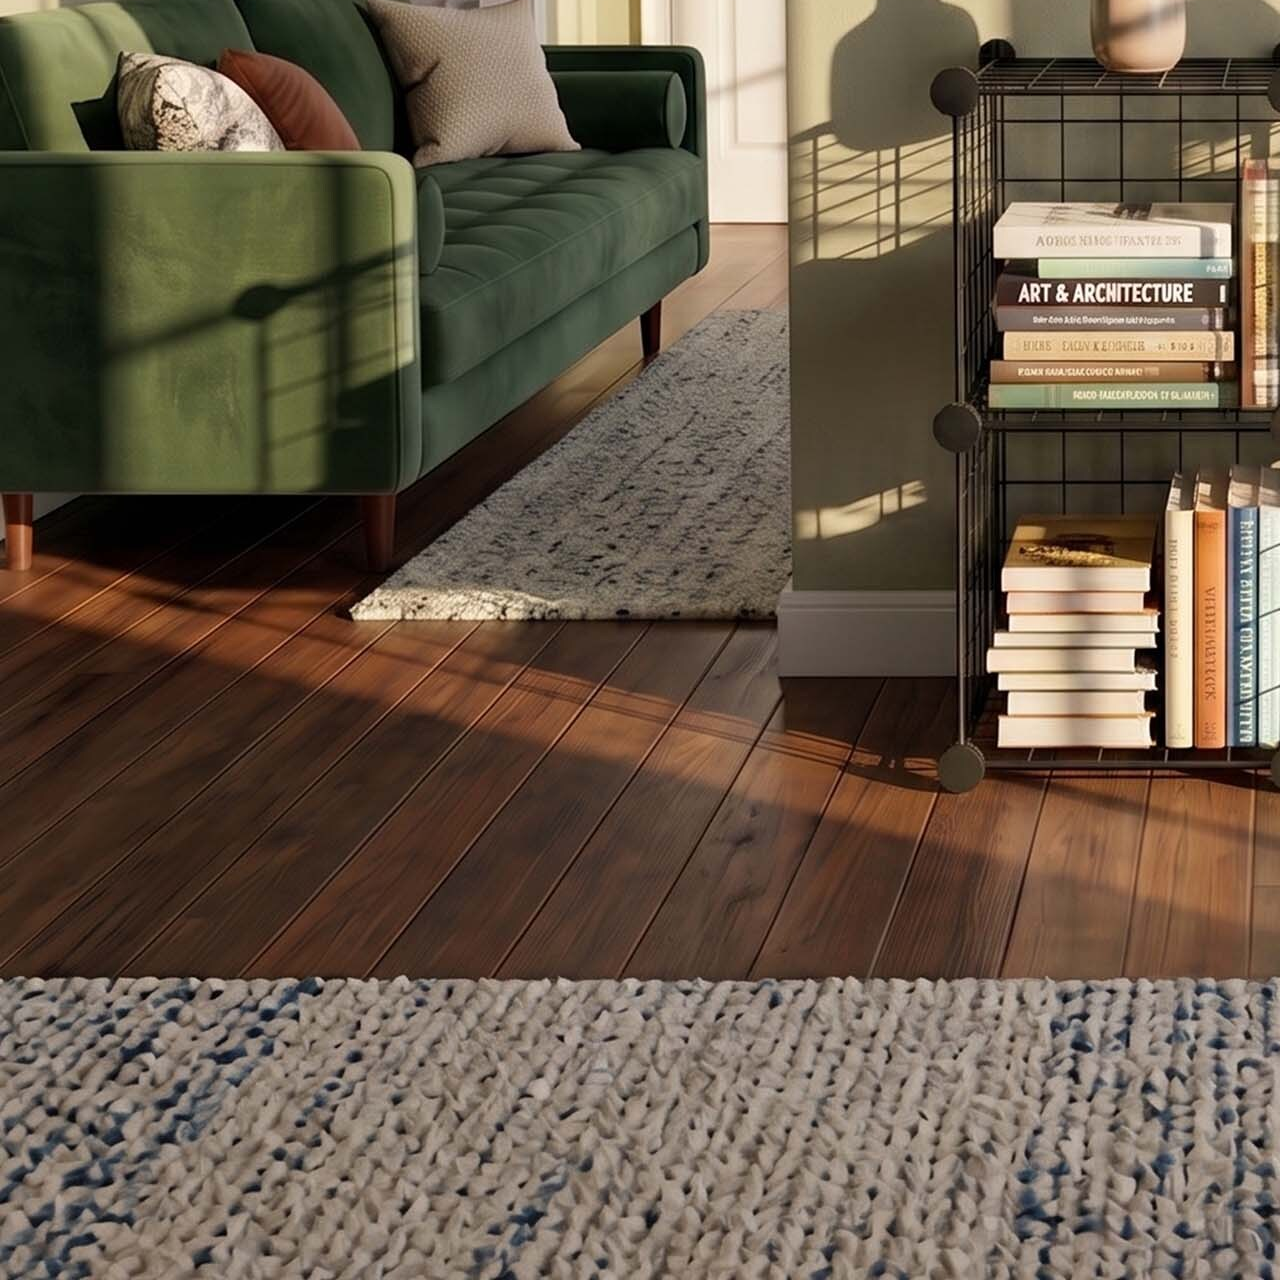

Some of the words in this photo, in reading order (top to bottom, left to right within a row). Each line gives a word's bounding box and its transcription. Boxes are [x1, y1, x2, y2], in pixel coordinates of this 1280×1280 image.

[1018, 283, 1052, 303] ART
[1055, 283, 1069, 303] &
[1072, 283, 1193, 303] ARCHITECTURE
